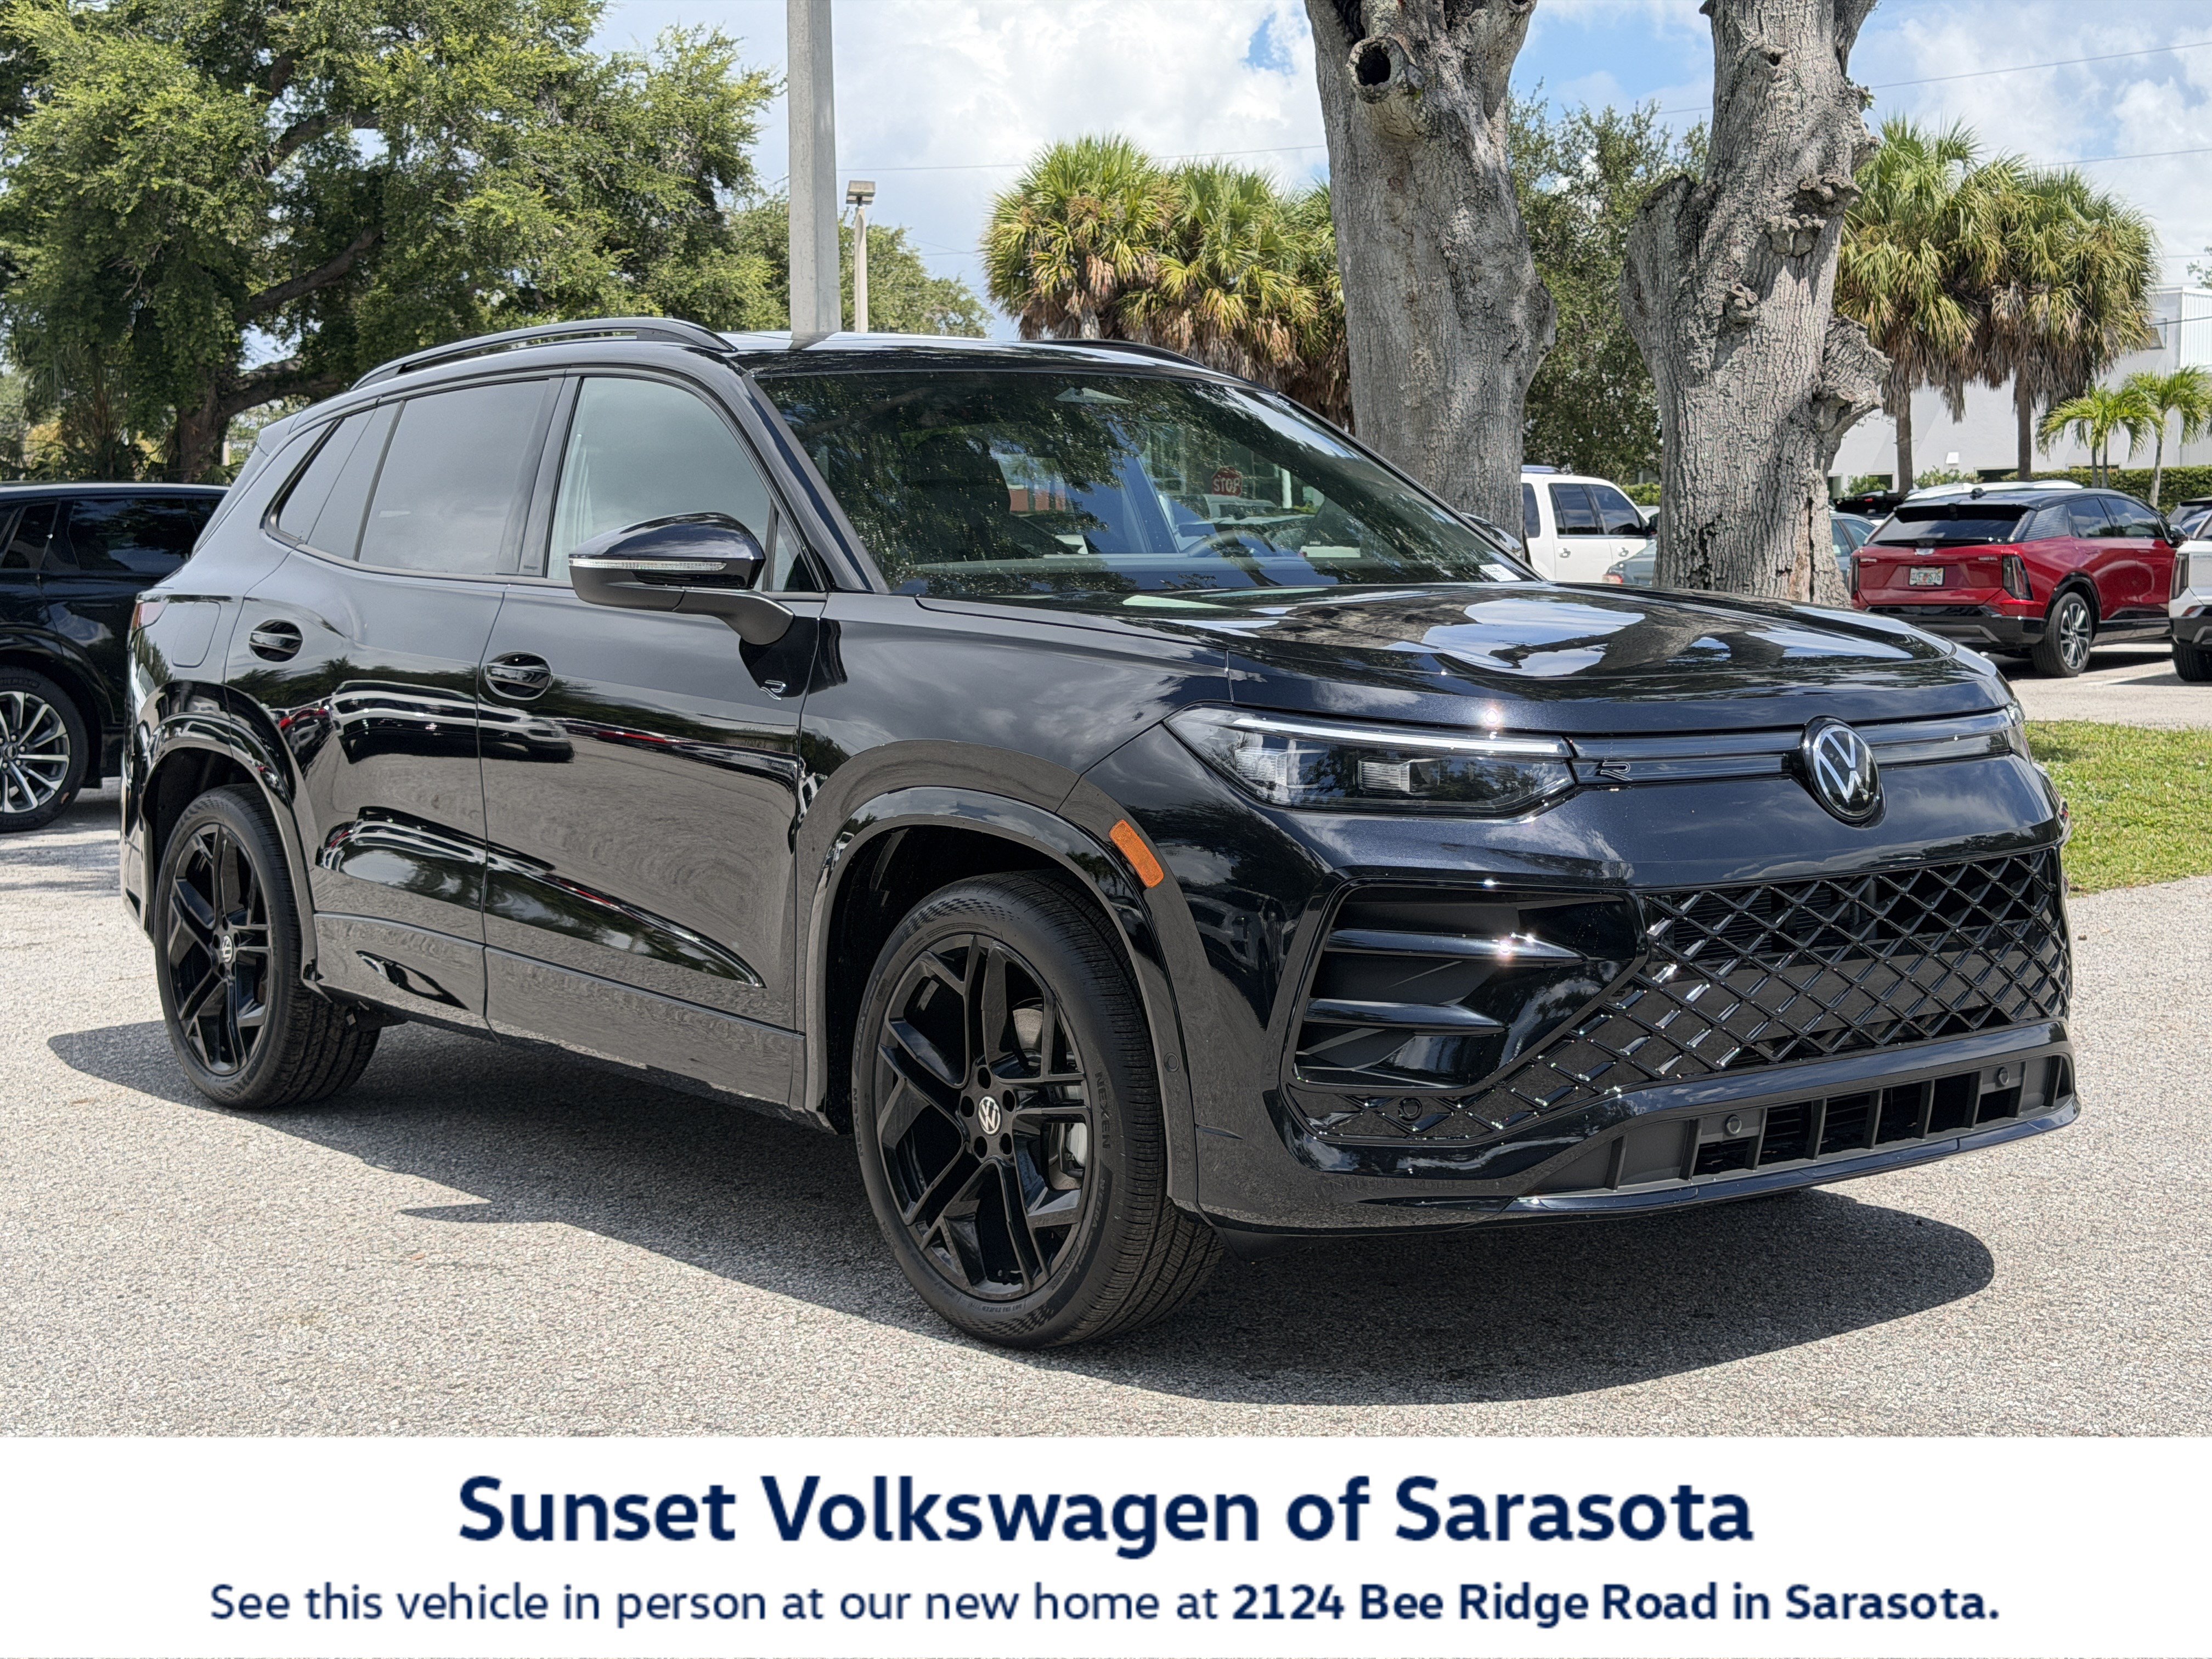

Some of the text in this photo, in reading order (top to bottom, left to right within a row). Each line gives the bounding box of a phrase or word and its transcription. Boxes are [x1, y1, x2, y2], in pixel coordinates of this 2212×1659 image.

[1213, 477, 1240, 494] STOP
[760, 680, 786, 701] R
[1600, 761, 1633, 781] R
[1094, 1071, 1111, 1149] NEXEN
